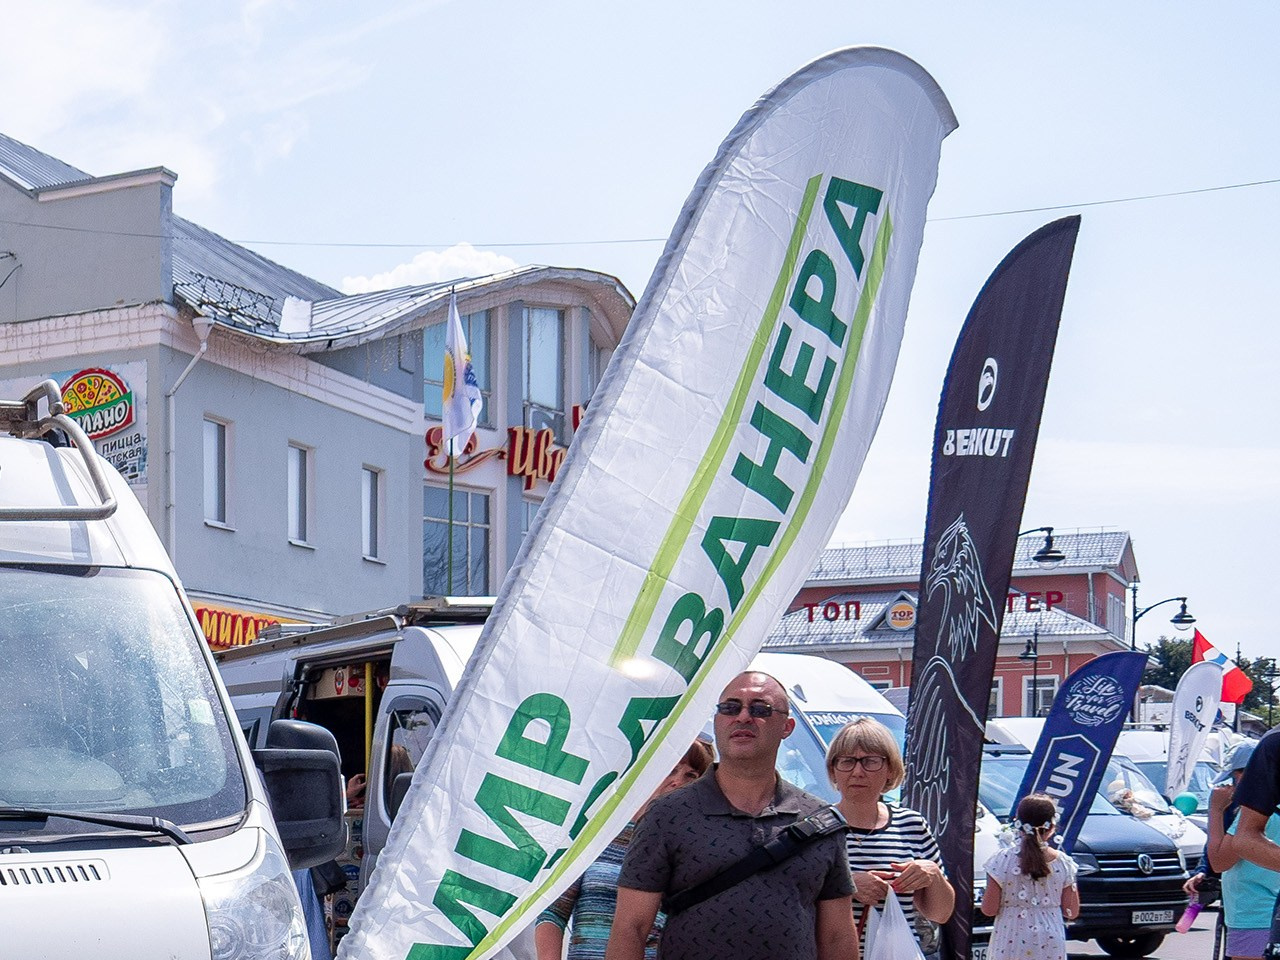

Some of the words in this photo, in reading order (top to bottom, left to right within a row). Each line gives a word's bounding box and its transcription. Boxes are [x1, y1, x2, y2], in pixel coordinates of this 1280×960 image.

[103, 433, 141, 455] пицца
[943, 428, 1014, 457] BERKUT
[803, 600, 861, 623] ТОП
[1008, 590, 1064, 613] ТЕР
[1066, 693, 1120, 718] Travel
